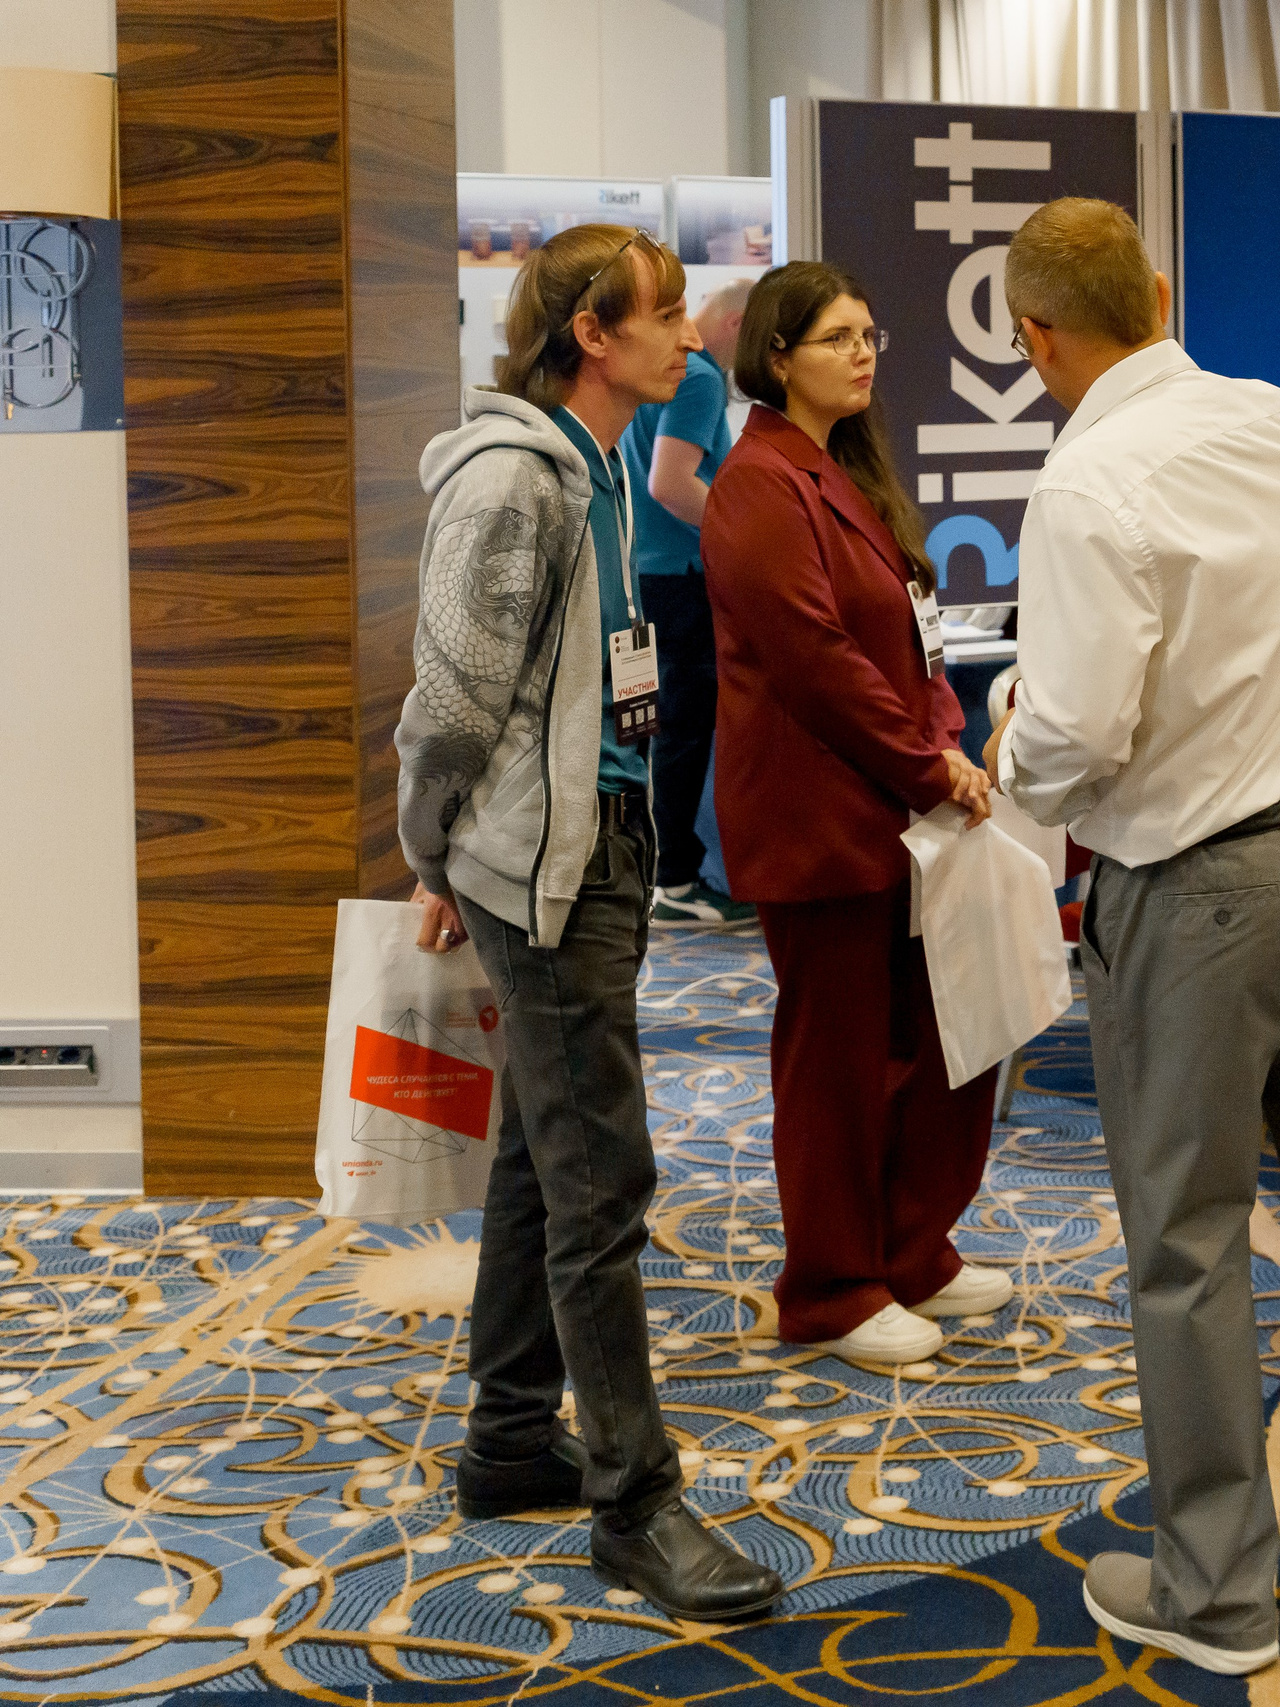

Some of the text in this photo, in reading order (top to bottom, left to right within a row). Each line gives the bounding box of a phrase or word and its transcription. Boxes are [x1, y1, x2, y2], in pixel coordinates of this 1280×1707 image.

[617, 680, 657, 699] УЧАСТНИК
[366, 1075, 399, 1085] ЧУДЕСА
[393, 1090, 410, 1098] КТО
